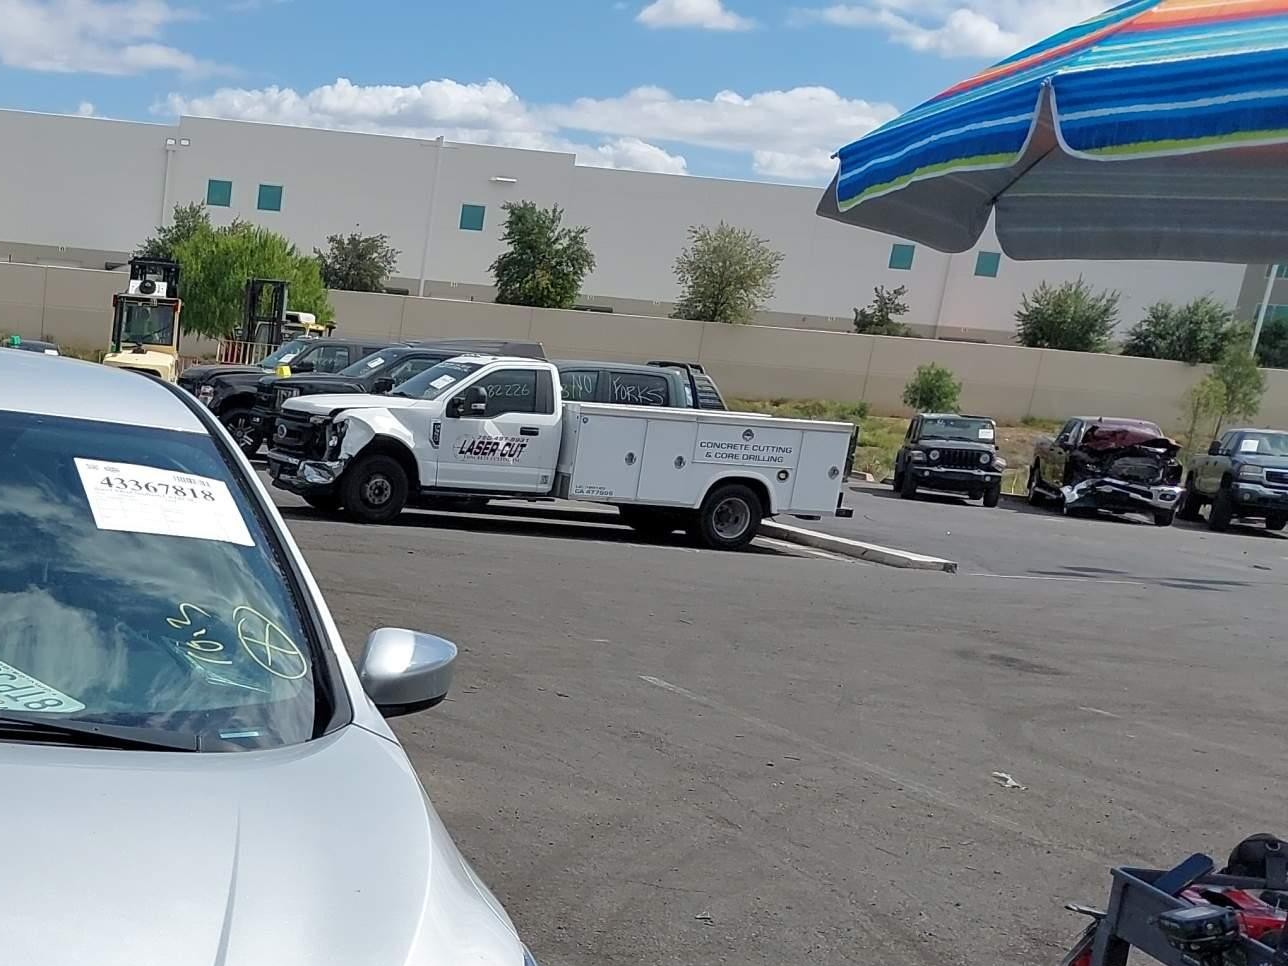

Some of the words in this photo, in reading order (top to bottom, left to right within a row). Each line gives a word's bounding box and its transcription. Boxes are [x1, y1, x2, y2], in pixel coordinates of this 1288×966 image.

[613, 376, 664, 405] FORKS
[458, 439, 500, 457] LASER
[499, 441, 527, 458] CUT
[699, 441, 750, 451] CONCRETE
[751, 444, 793, 454] CUTTING
[714, 451, 741, 461] CORE
[741, 453, 784, 463] DRILLING
[100, 475, 216, 502] 43367818
